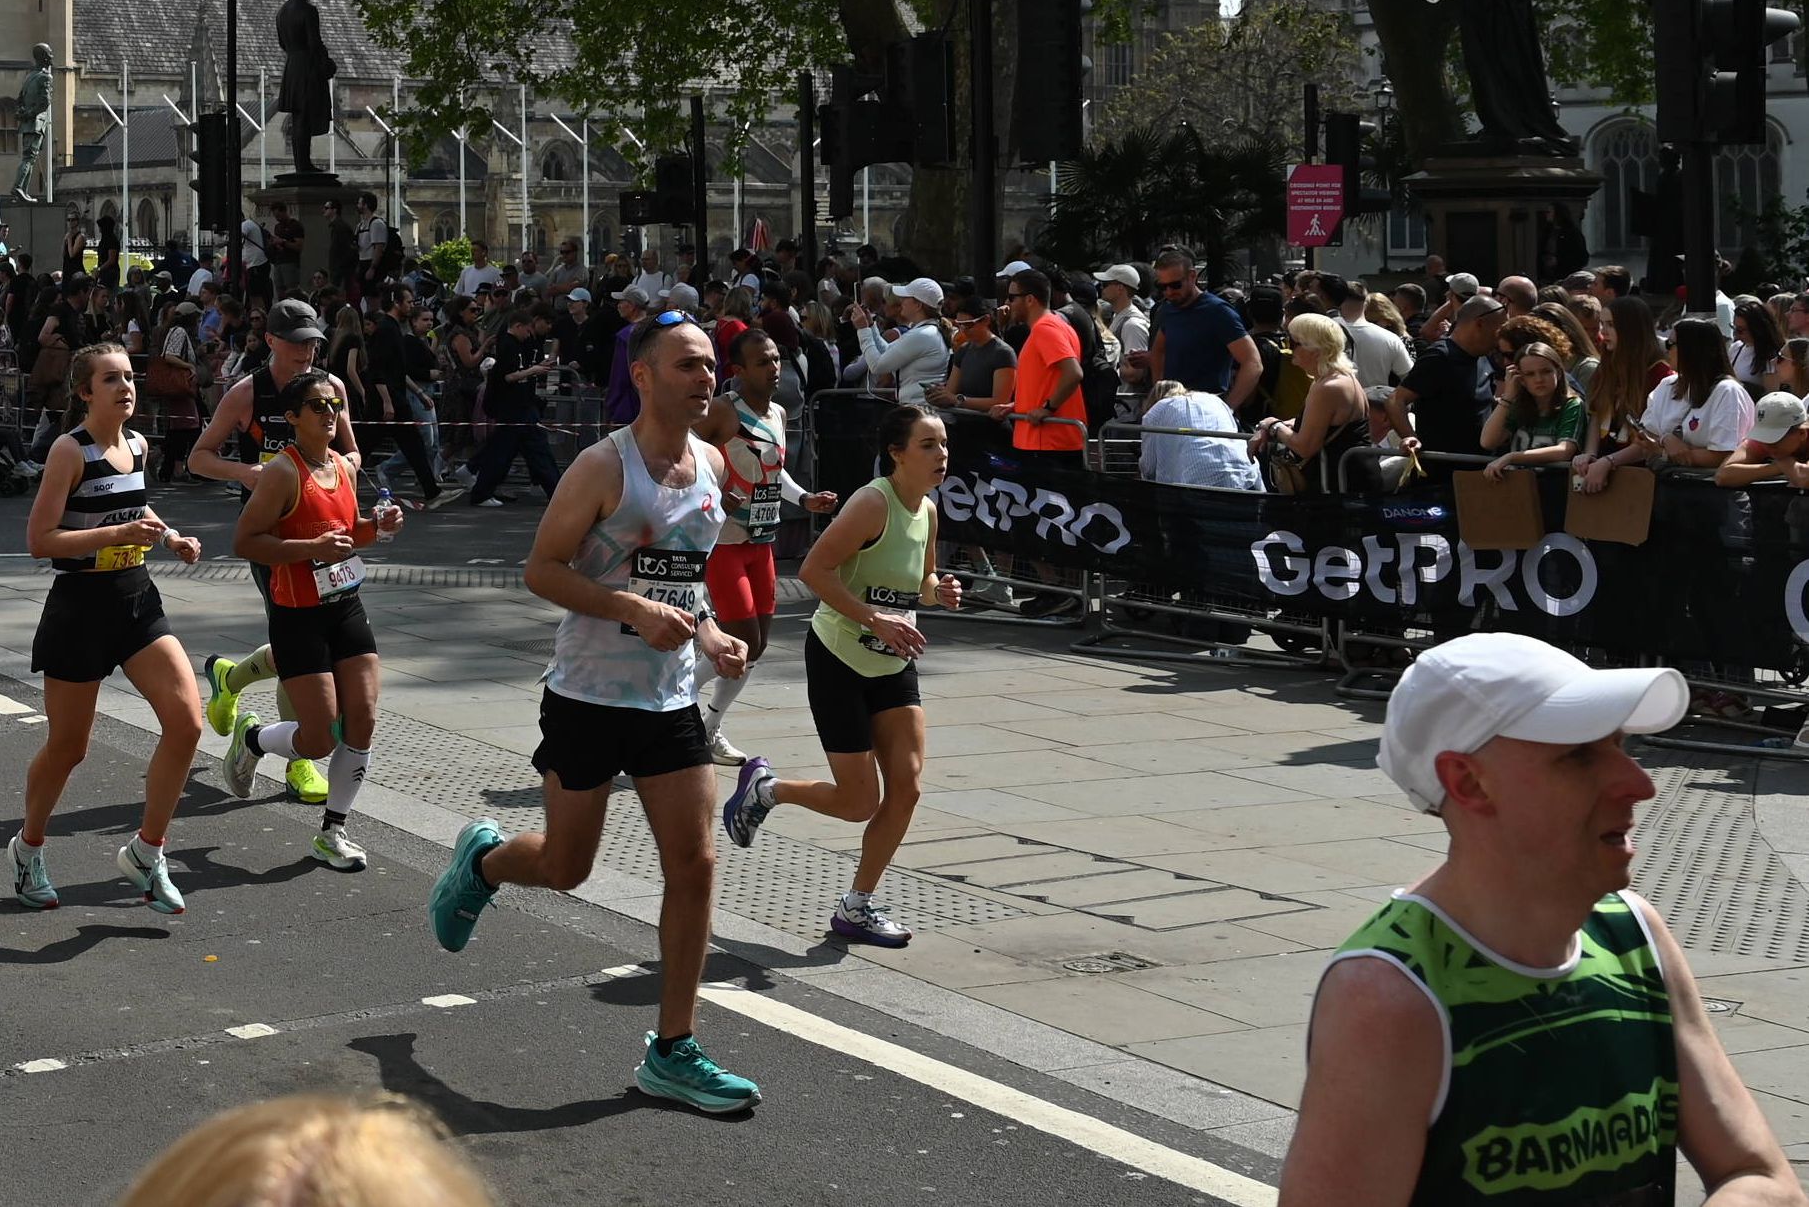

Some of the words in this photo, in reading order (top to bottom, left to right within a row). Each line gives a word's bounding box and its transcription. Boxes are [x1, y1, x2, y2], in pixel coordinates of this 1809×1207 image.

[264, 435, 285, 450] tcs
[93, 481, 115, 493] soar
[929, 469, 1132, 555] etPRO
[637, 553, 668, 576] tcs
[672, 555, 687, 563] TATA
[329, 566, 356, 588] 9478
[1251, 530, 1598, 617] GetPRO
[642, 587, 696, 611] 47649
[870, 586, 896, 603] tcs
